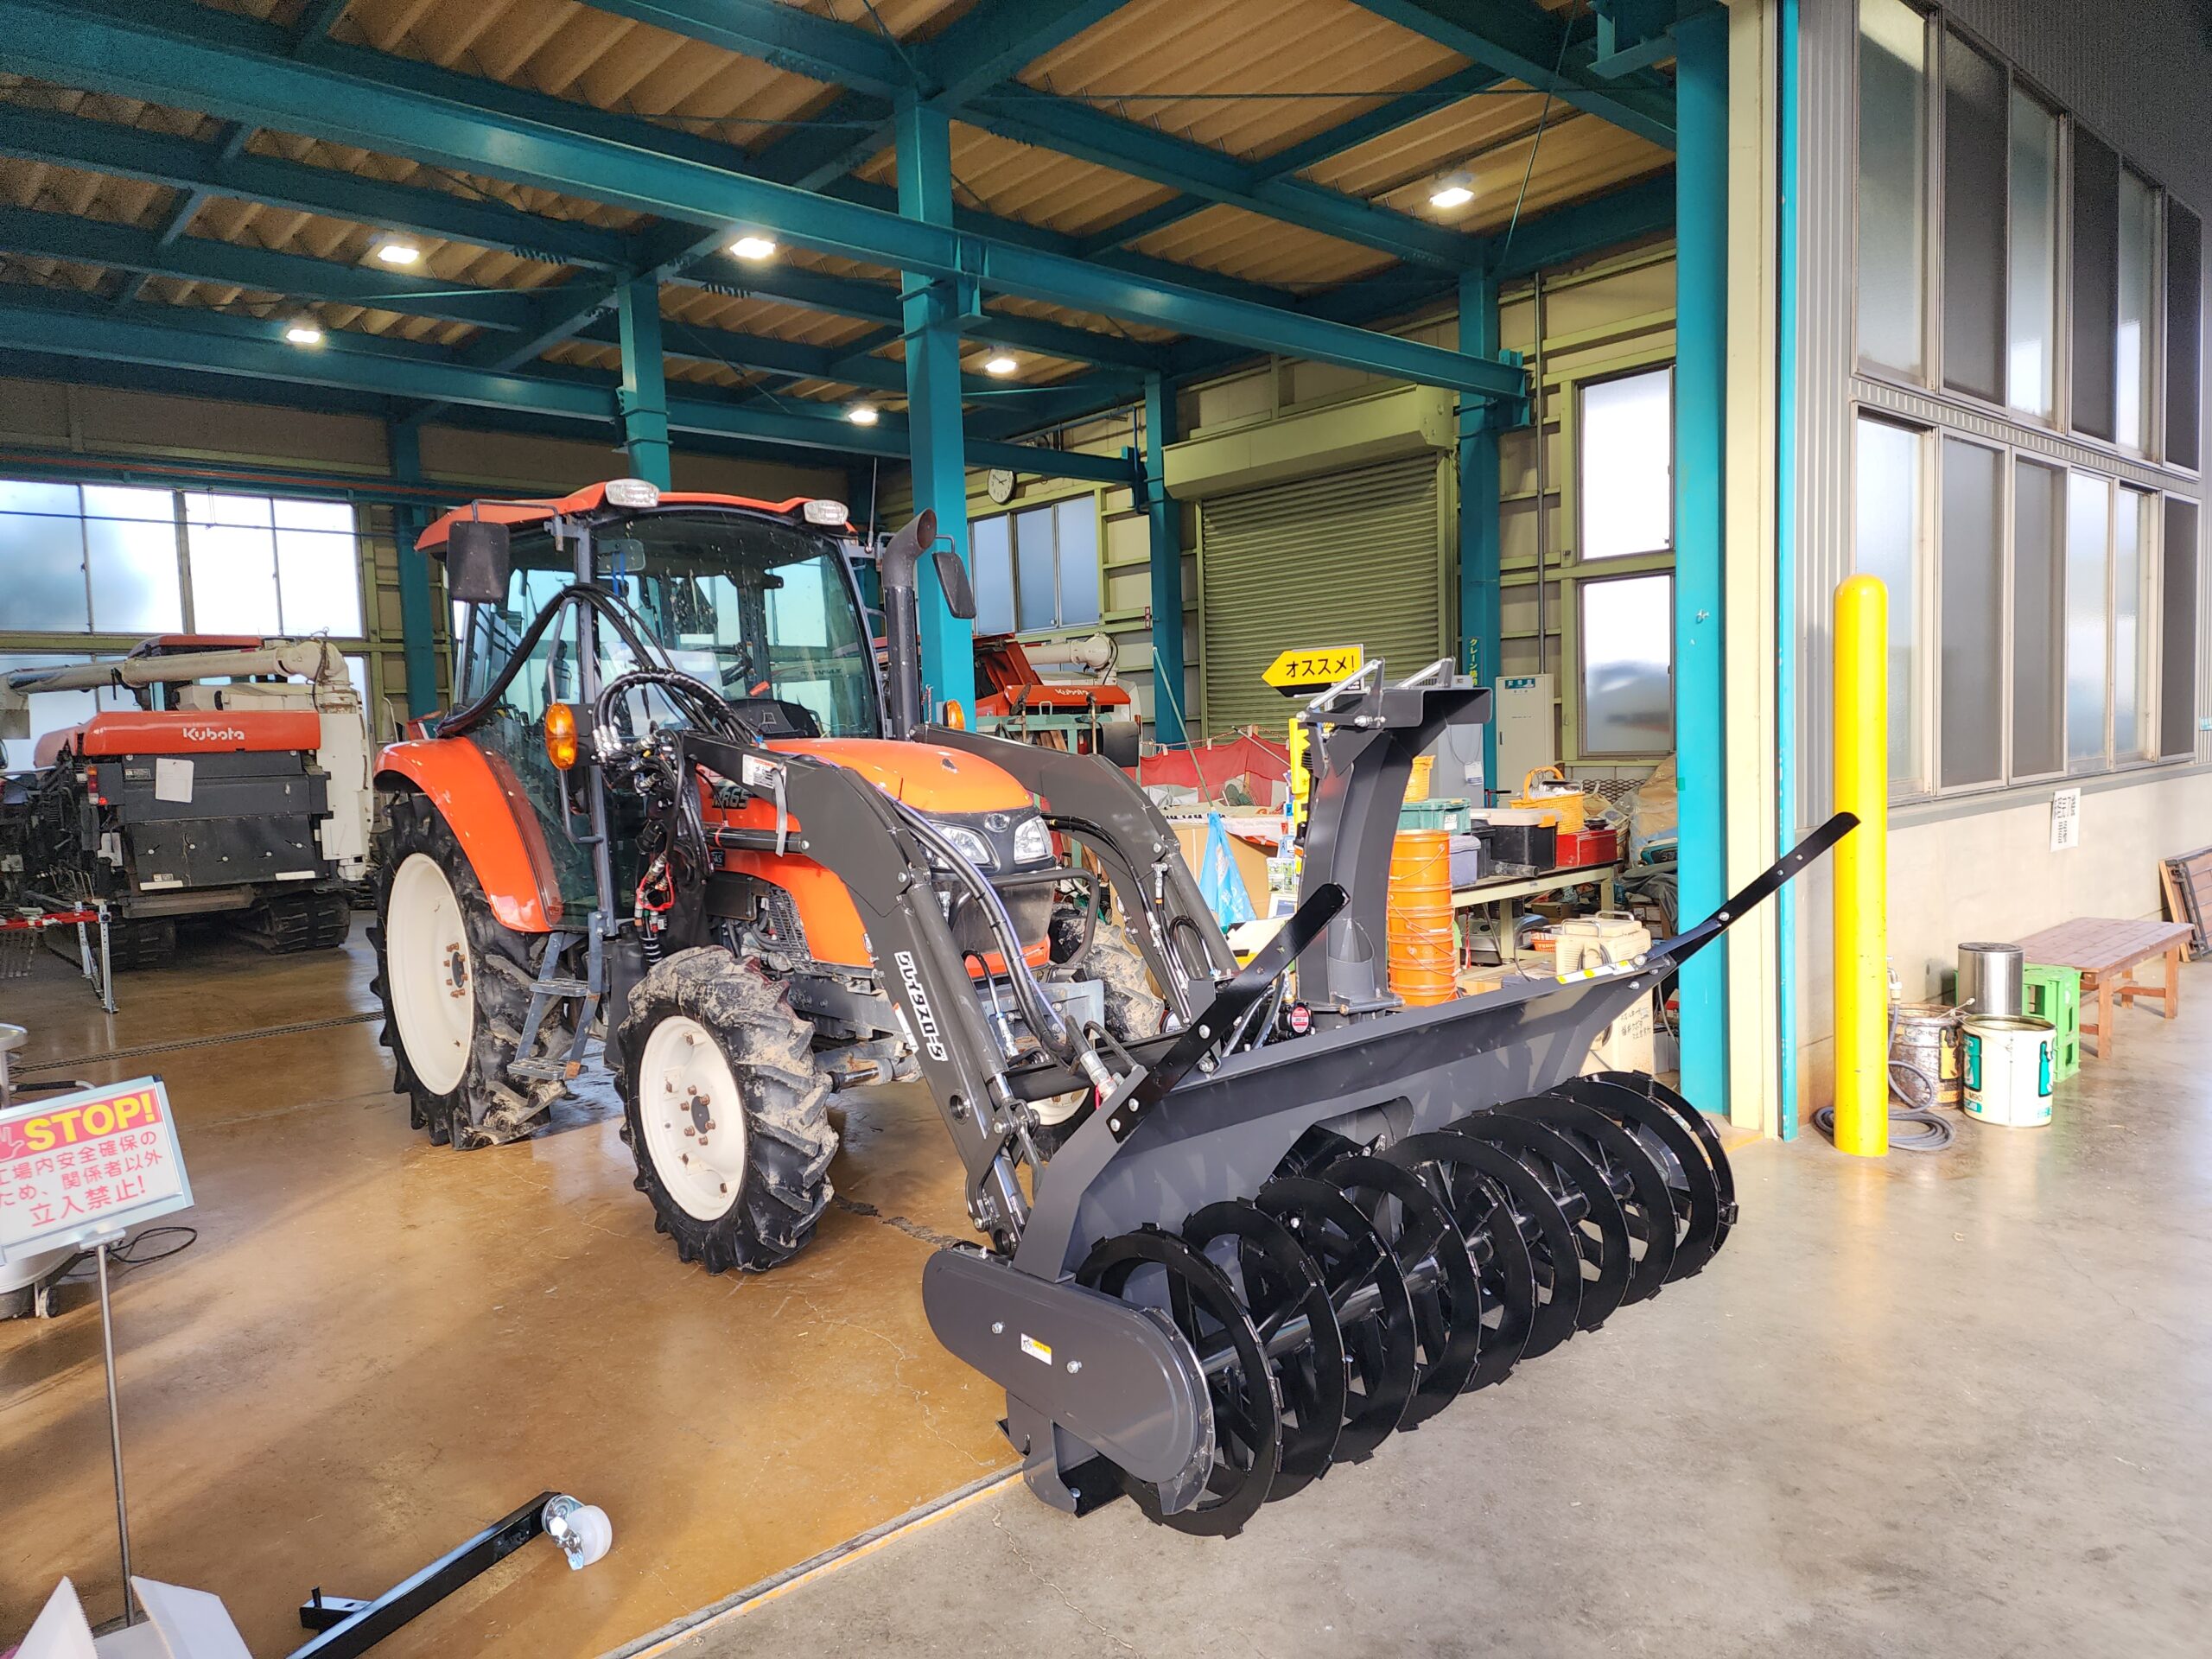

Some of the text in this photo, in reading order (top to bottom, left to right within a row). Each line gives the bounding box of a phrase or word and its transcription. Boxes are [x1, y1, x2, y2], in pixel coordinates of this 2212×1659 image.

[1286, 655, 1355, 677] オススメ!
[182, 728, 245, 741] Kubota
[23, 1093, 156, 1151] STOP!
[29, 1175, 146, 1227] 立入禁止!
